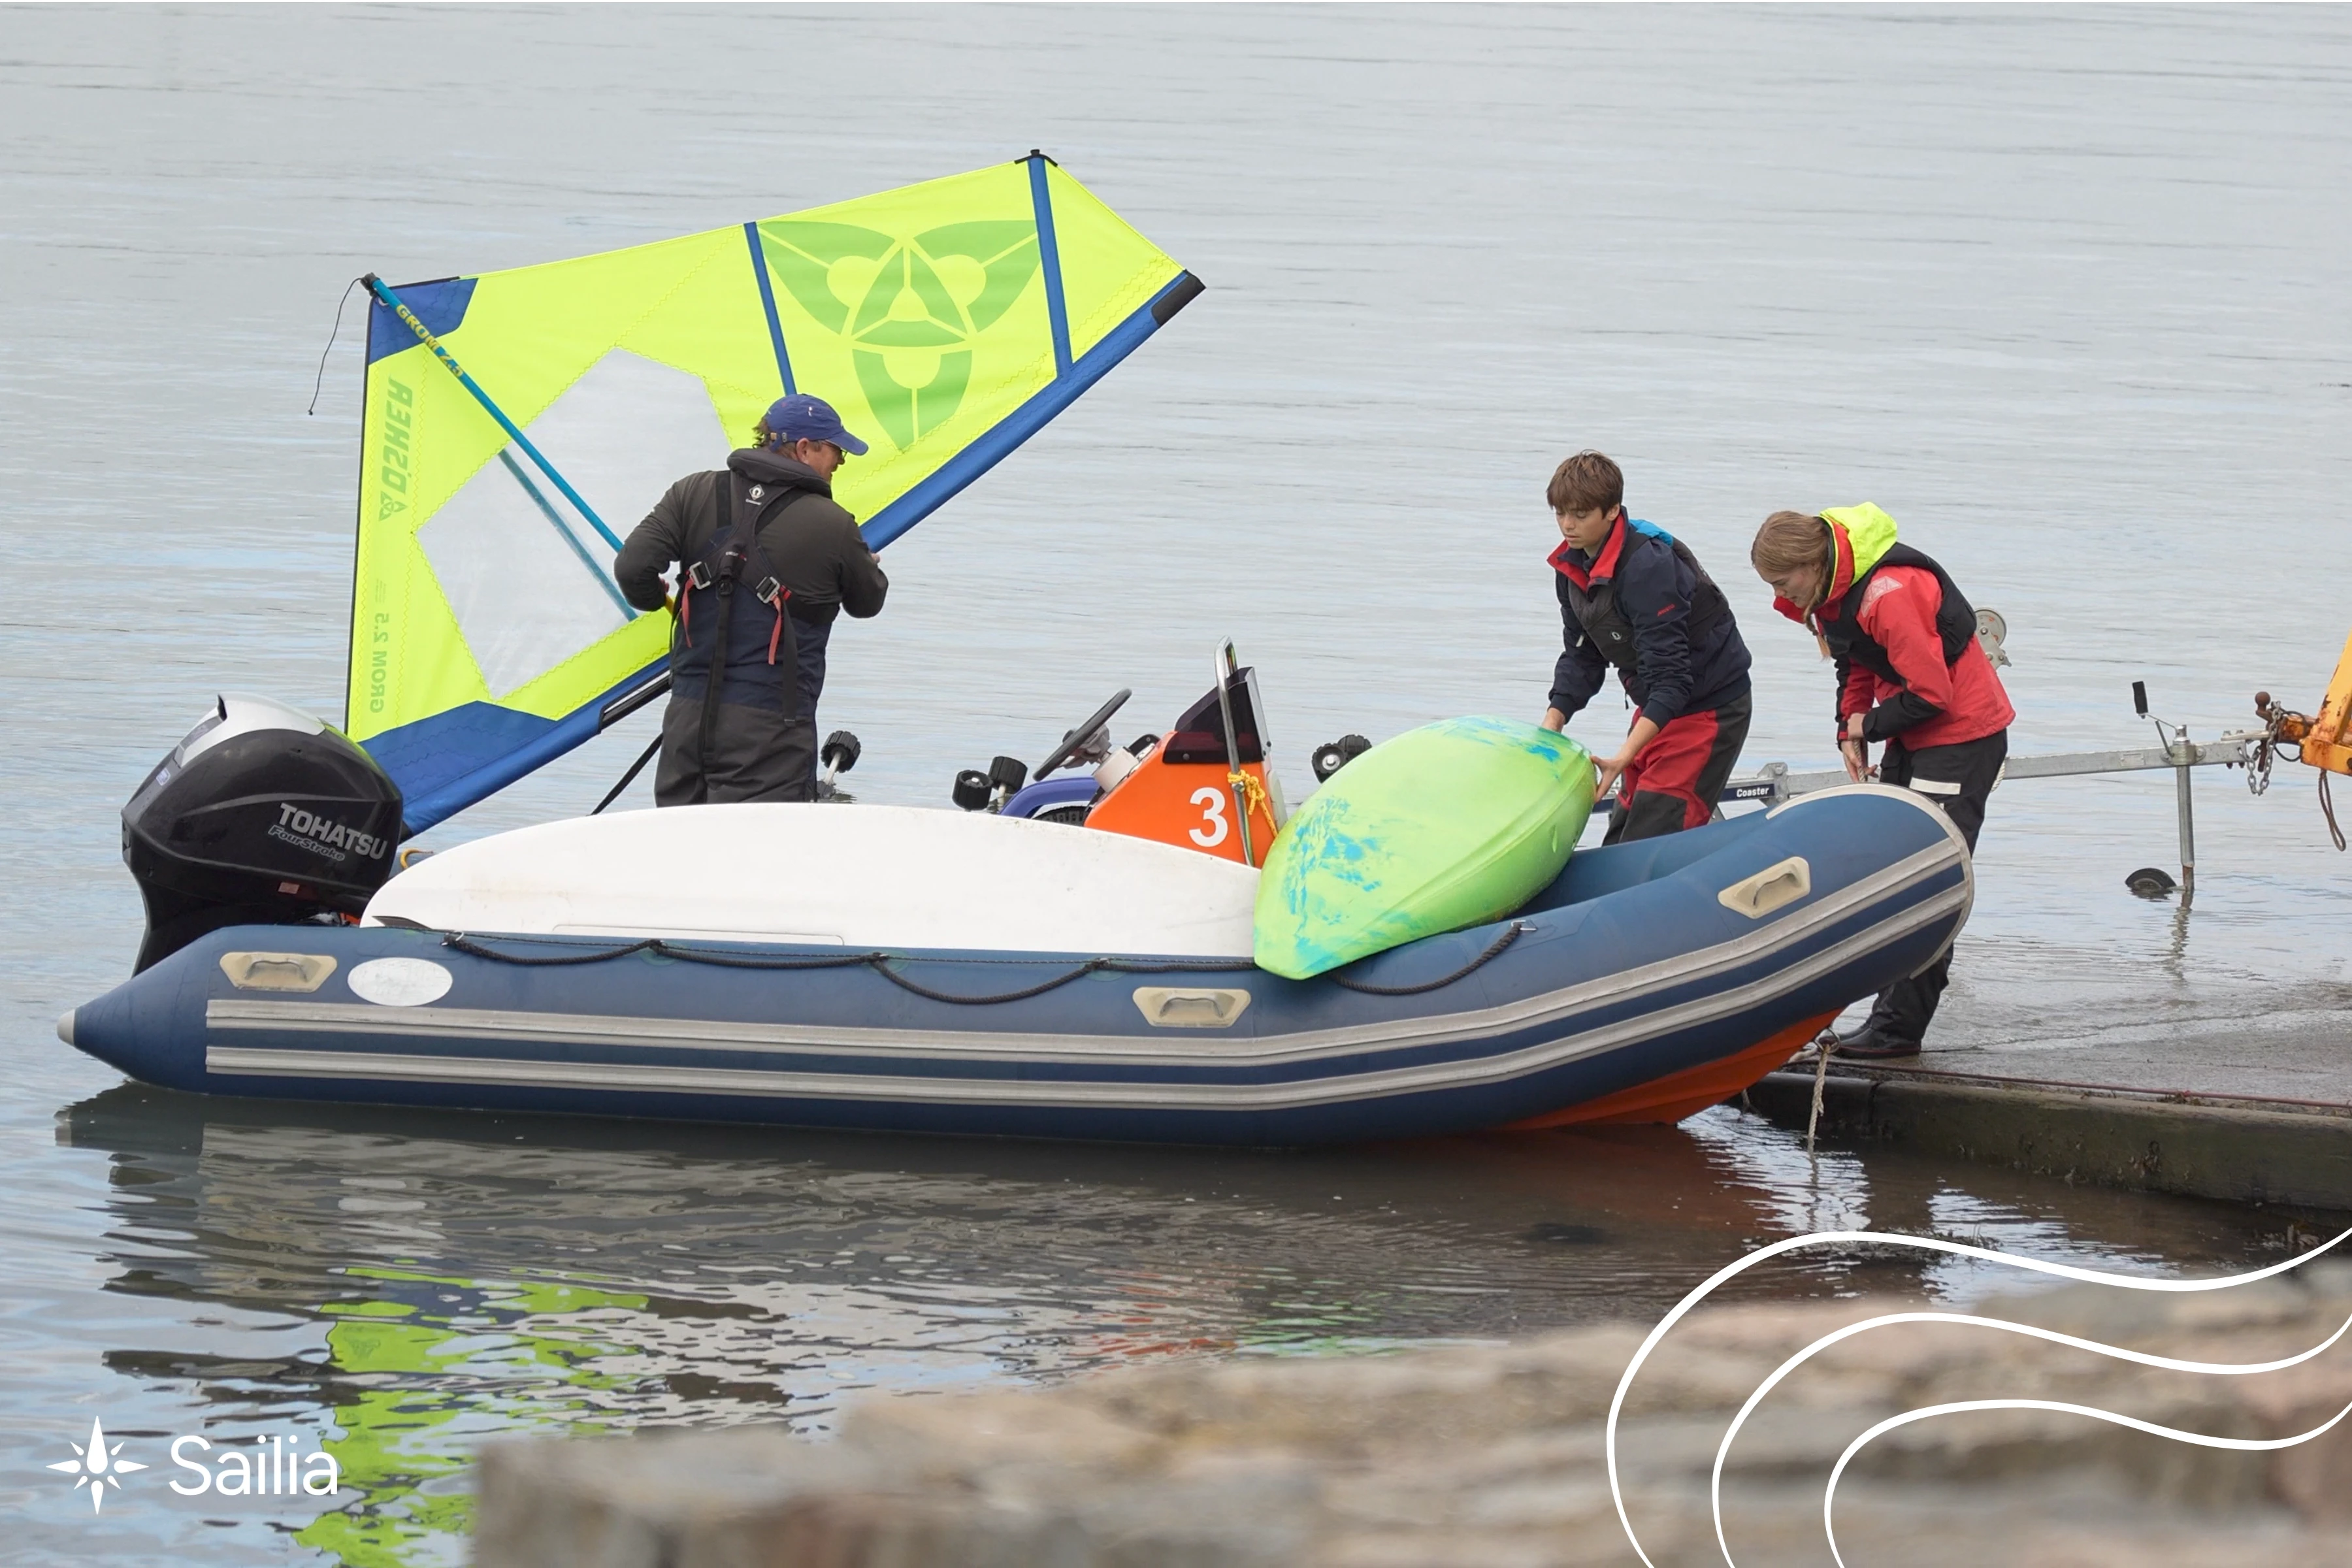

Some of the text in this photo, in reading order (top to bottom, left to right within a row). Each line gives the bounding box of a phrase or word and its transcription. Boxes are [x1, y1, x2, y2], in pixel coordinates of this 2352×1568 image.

[396, 304, 463, 378] GROM 2.5
[1188, 787, 1228, 847] 3
[1736, 787, 1770, 798] Coaster
[268, 825, 345, 861] FourStroke
[280, 802, 388, 860] TOHATSU
